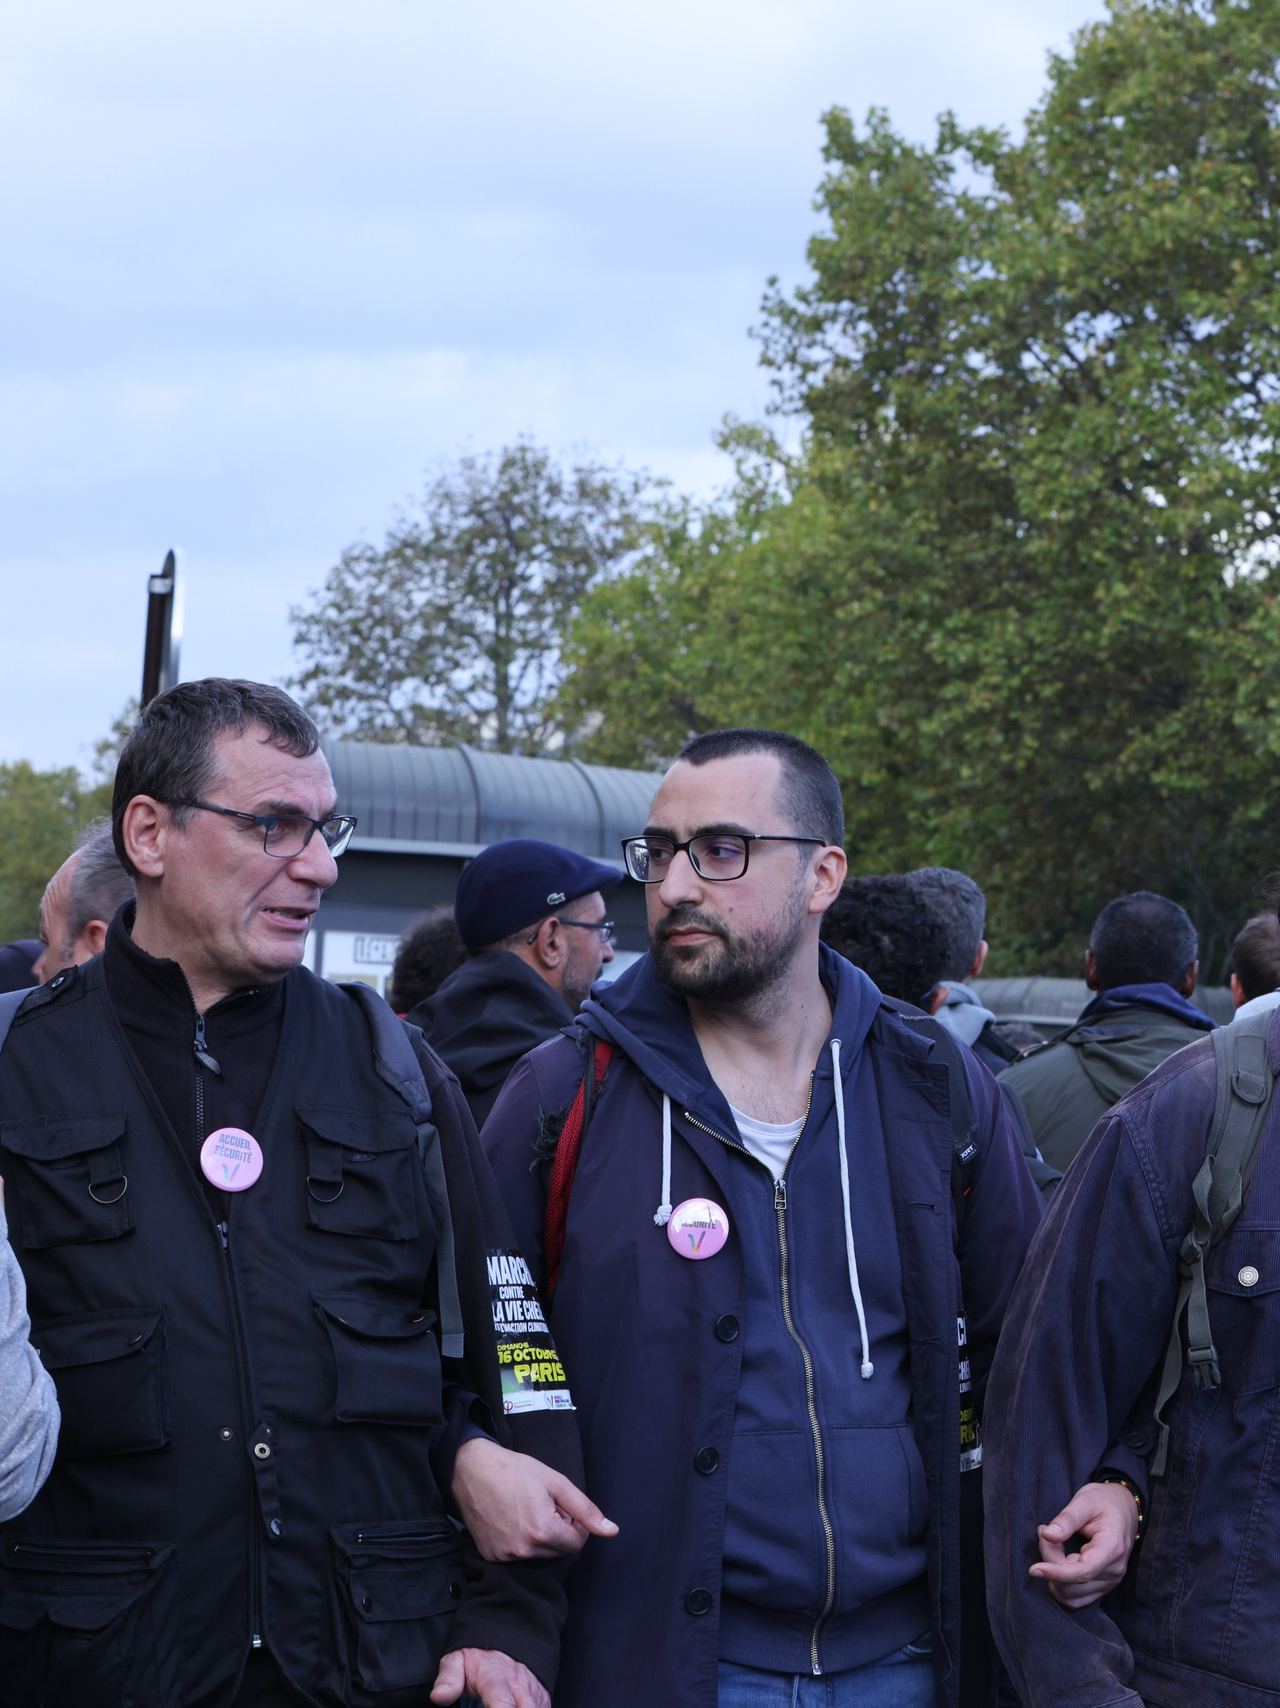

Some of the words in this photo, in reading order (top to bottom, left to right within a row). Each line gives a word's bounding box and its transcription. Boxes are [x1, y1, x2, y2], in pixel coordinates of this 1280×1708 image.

[219, 1134, 251, 1151] ACCUEIL
[214, 1144, 253, 1164] SÉCURITÉ
[486, 1256, 535, 1287] MARCH
[499, 1286, 525, 1299] CONTRE
[504, 1300, 525, 1321] VIE
[497, 1342, 529, 1352] DIMANCHE
[498, 1350, 512, 1364] 16
[514, 1362, 567, 1384] PARIS
